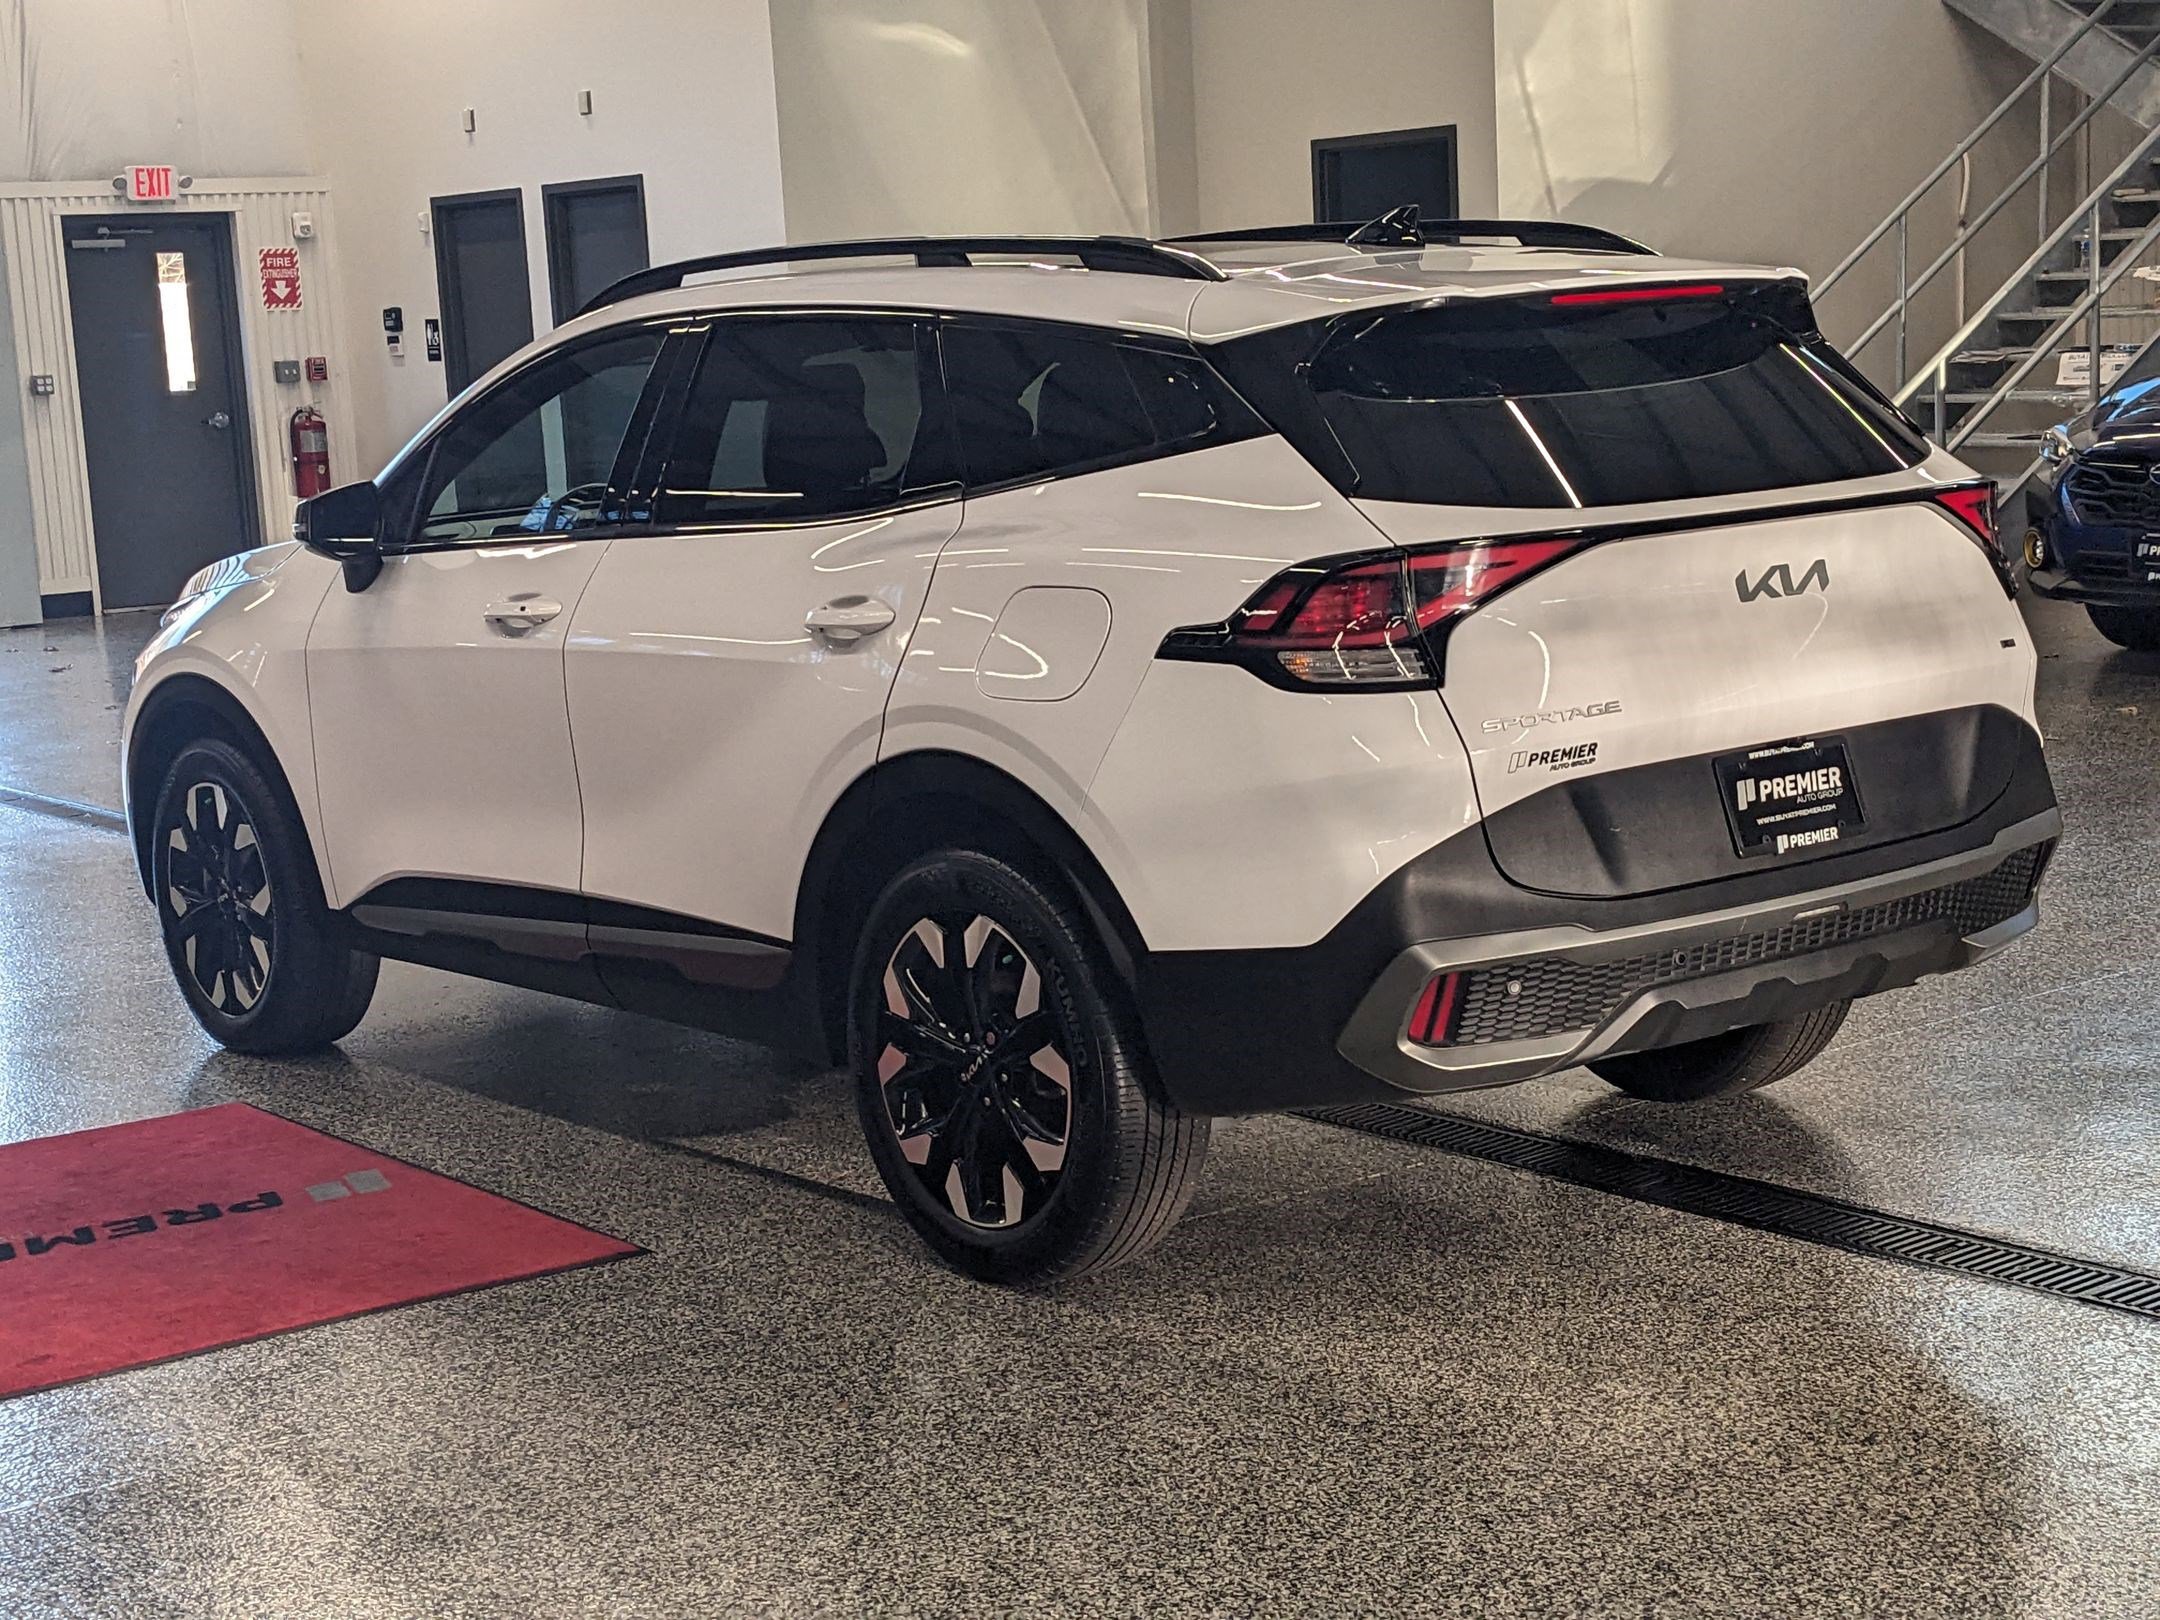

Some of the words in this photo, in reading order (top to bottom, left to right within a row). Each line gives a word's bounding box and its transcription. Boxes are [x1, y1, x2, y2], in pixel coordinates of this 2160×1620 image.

[135, 168, 171, 197] EXIT
[266, 257, 291, 267] FIRE
[1735, 558, 1830, 603] KIA
[1480, 700, 1623, 734] SPORTAGE
[1528, 742, 1599, 768] PREMIER
[1549, 762, 1570, 772] AUTO
[1571, 757, 1597, 768] GROUP
[1759, 766, 1843, 802] PREMIER
[1796, 794, 1817, 804] AUTO
[1817, 788, 1844, 801] GROUP
[1789, 826, 1839, 849] PREMIER
